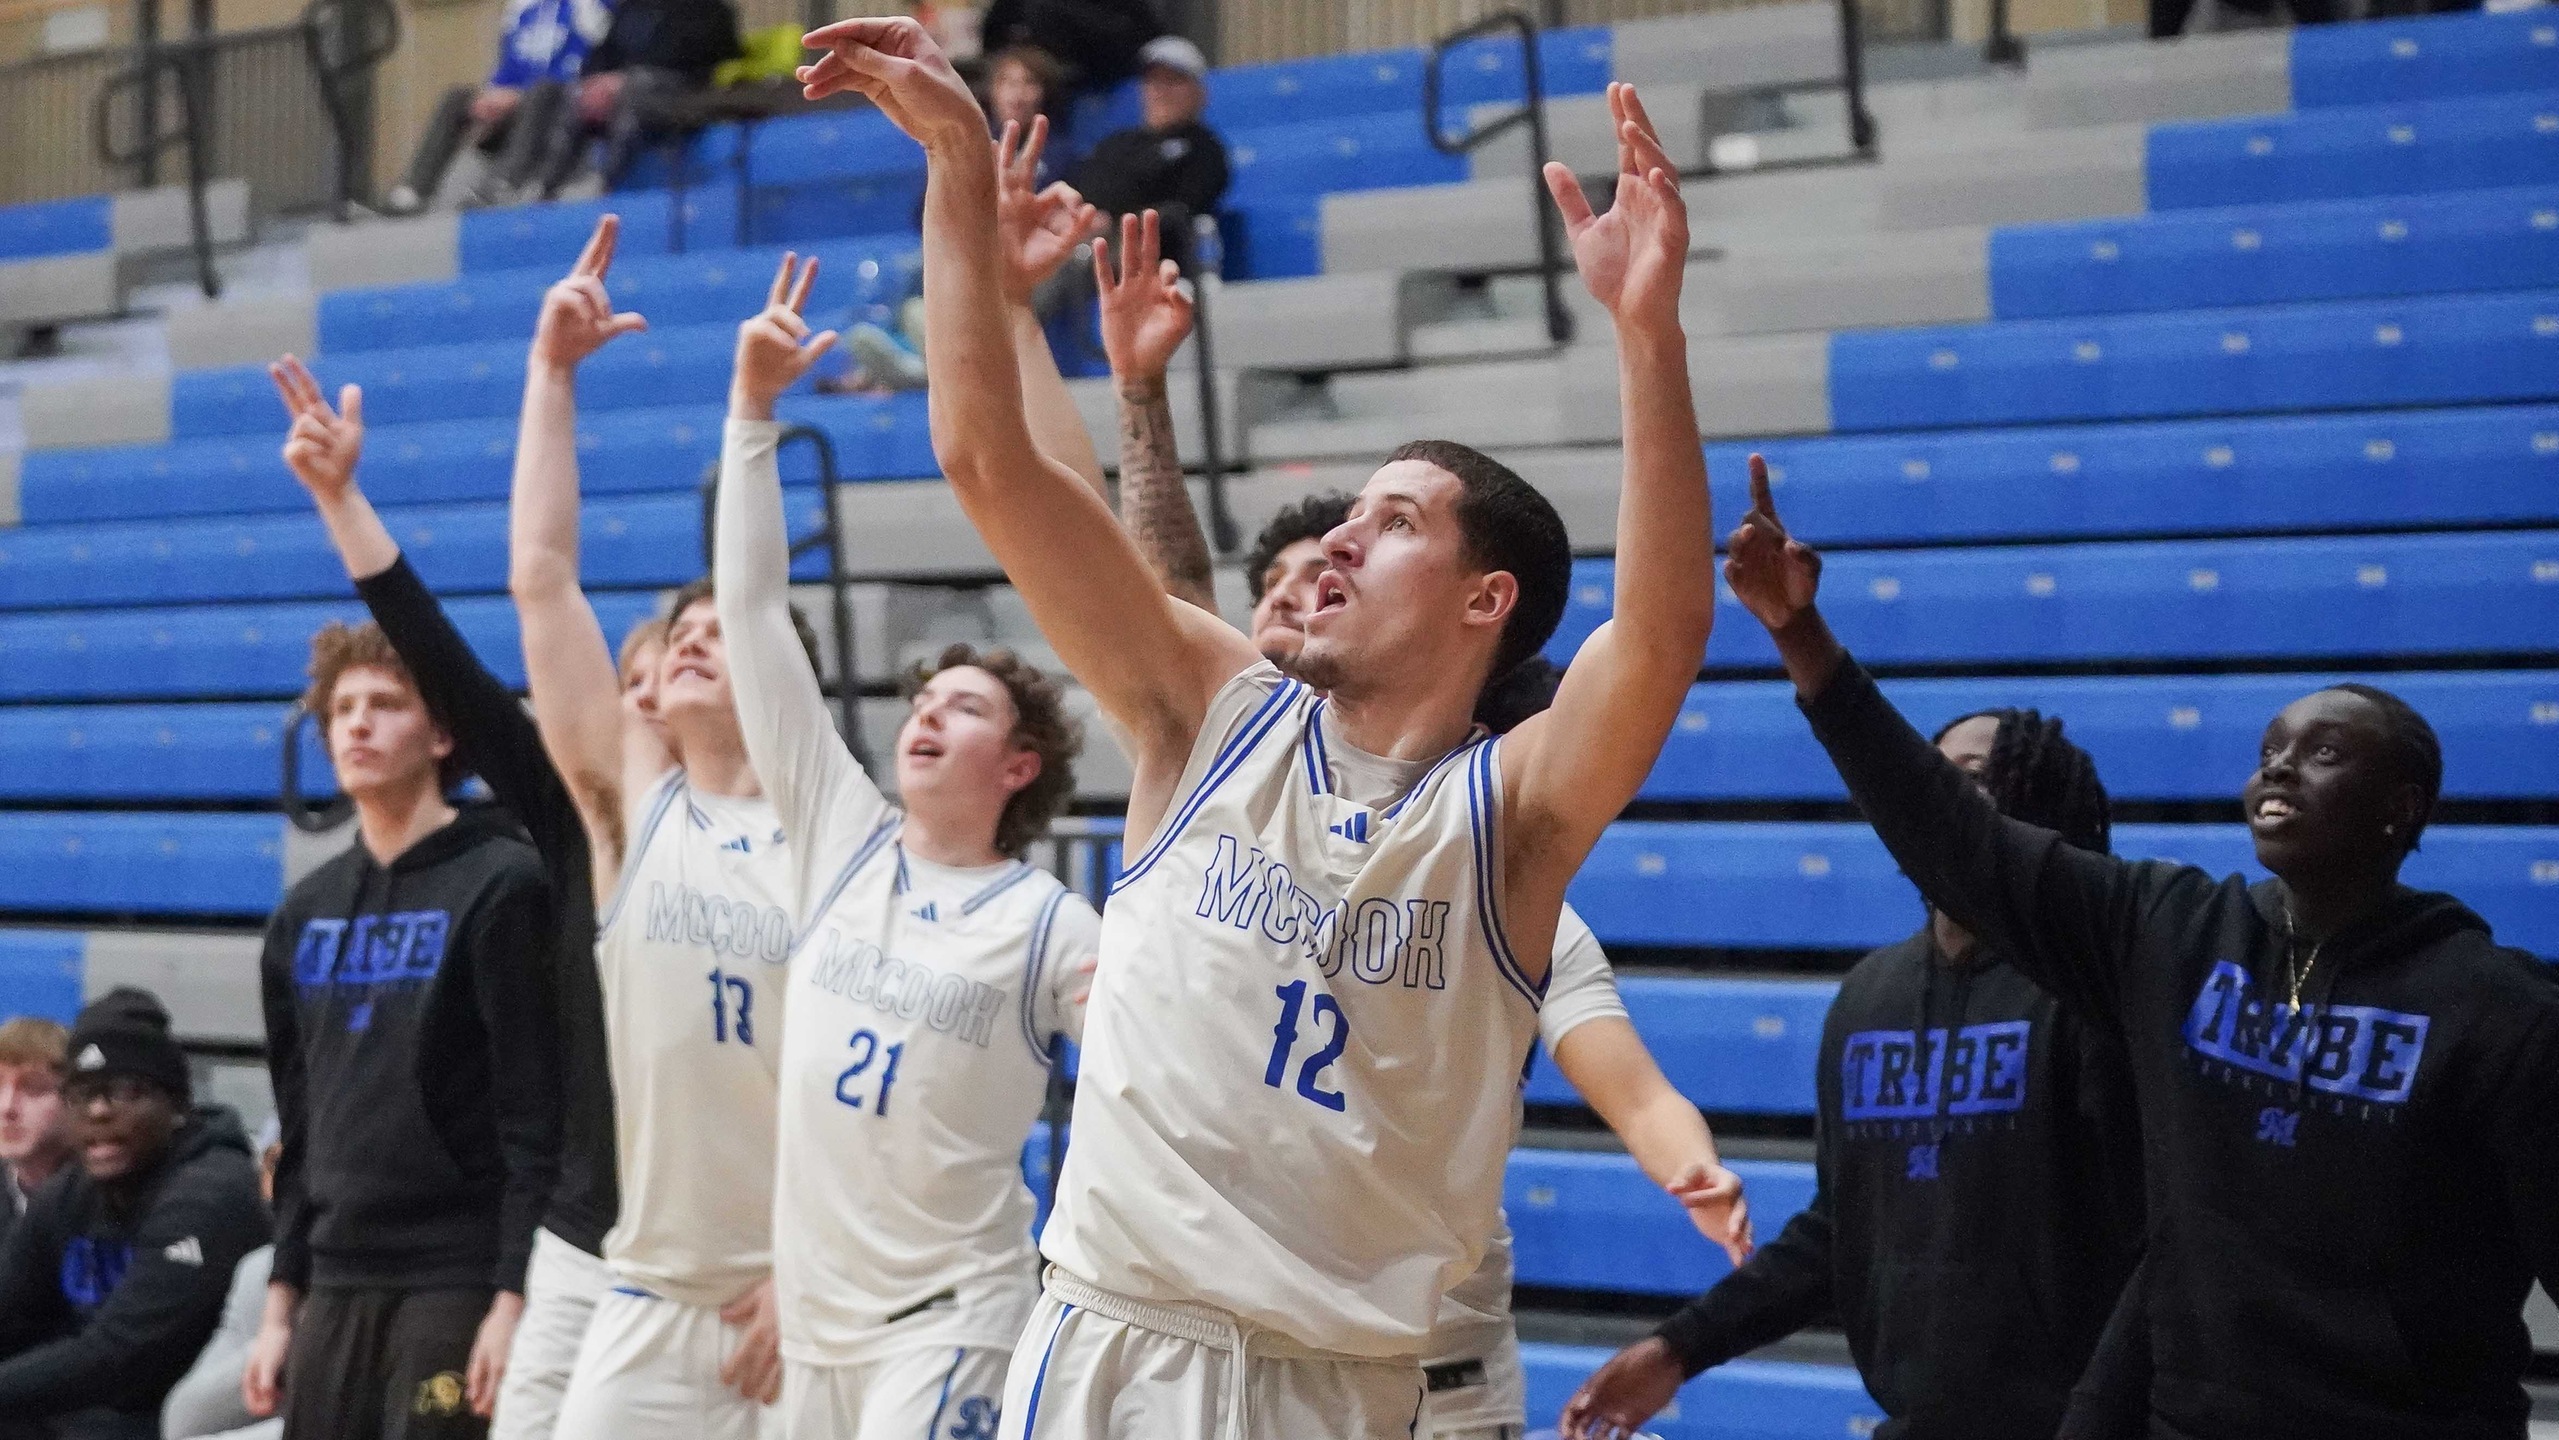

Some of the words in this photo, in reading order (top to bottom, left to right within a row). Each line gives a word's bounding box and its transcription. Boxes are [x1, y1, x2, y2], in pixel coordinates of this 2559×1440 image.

[305, 920, 441, 976] TIBE
[647, 879, 791, 965] MCCOO
[811, 927, 1006, 1049] MCCOOK
[835, 1029, 904, 1117] 21
[1264, 979, 1350, 1112] 12
[1850, 1034, 2021, 1108] TRIBE
